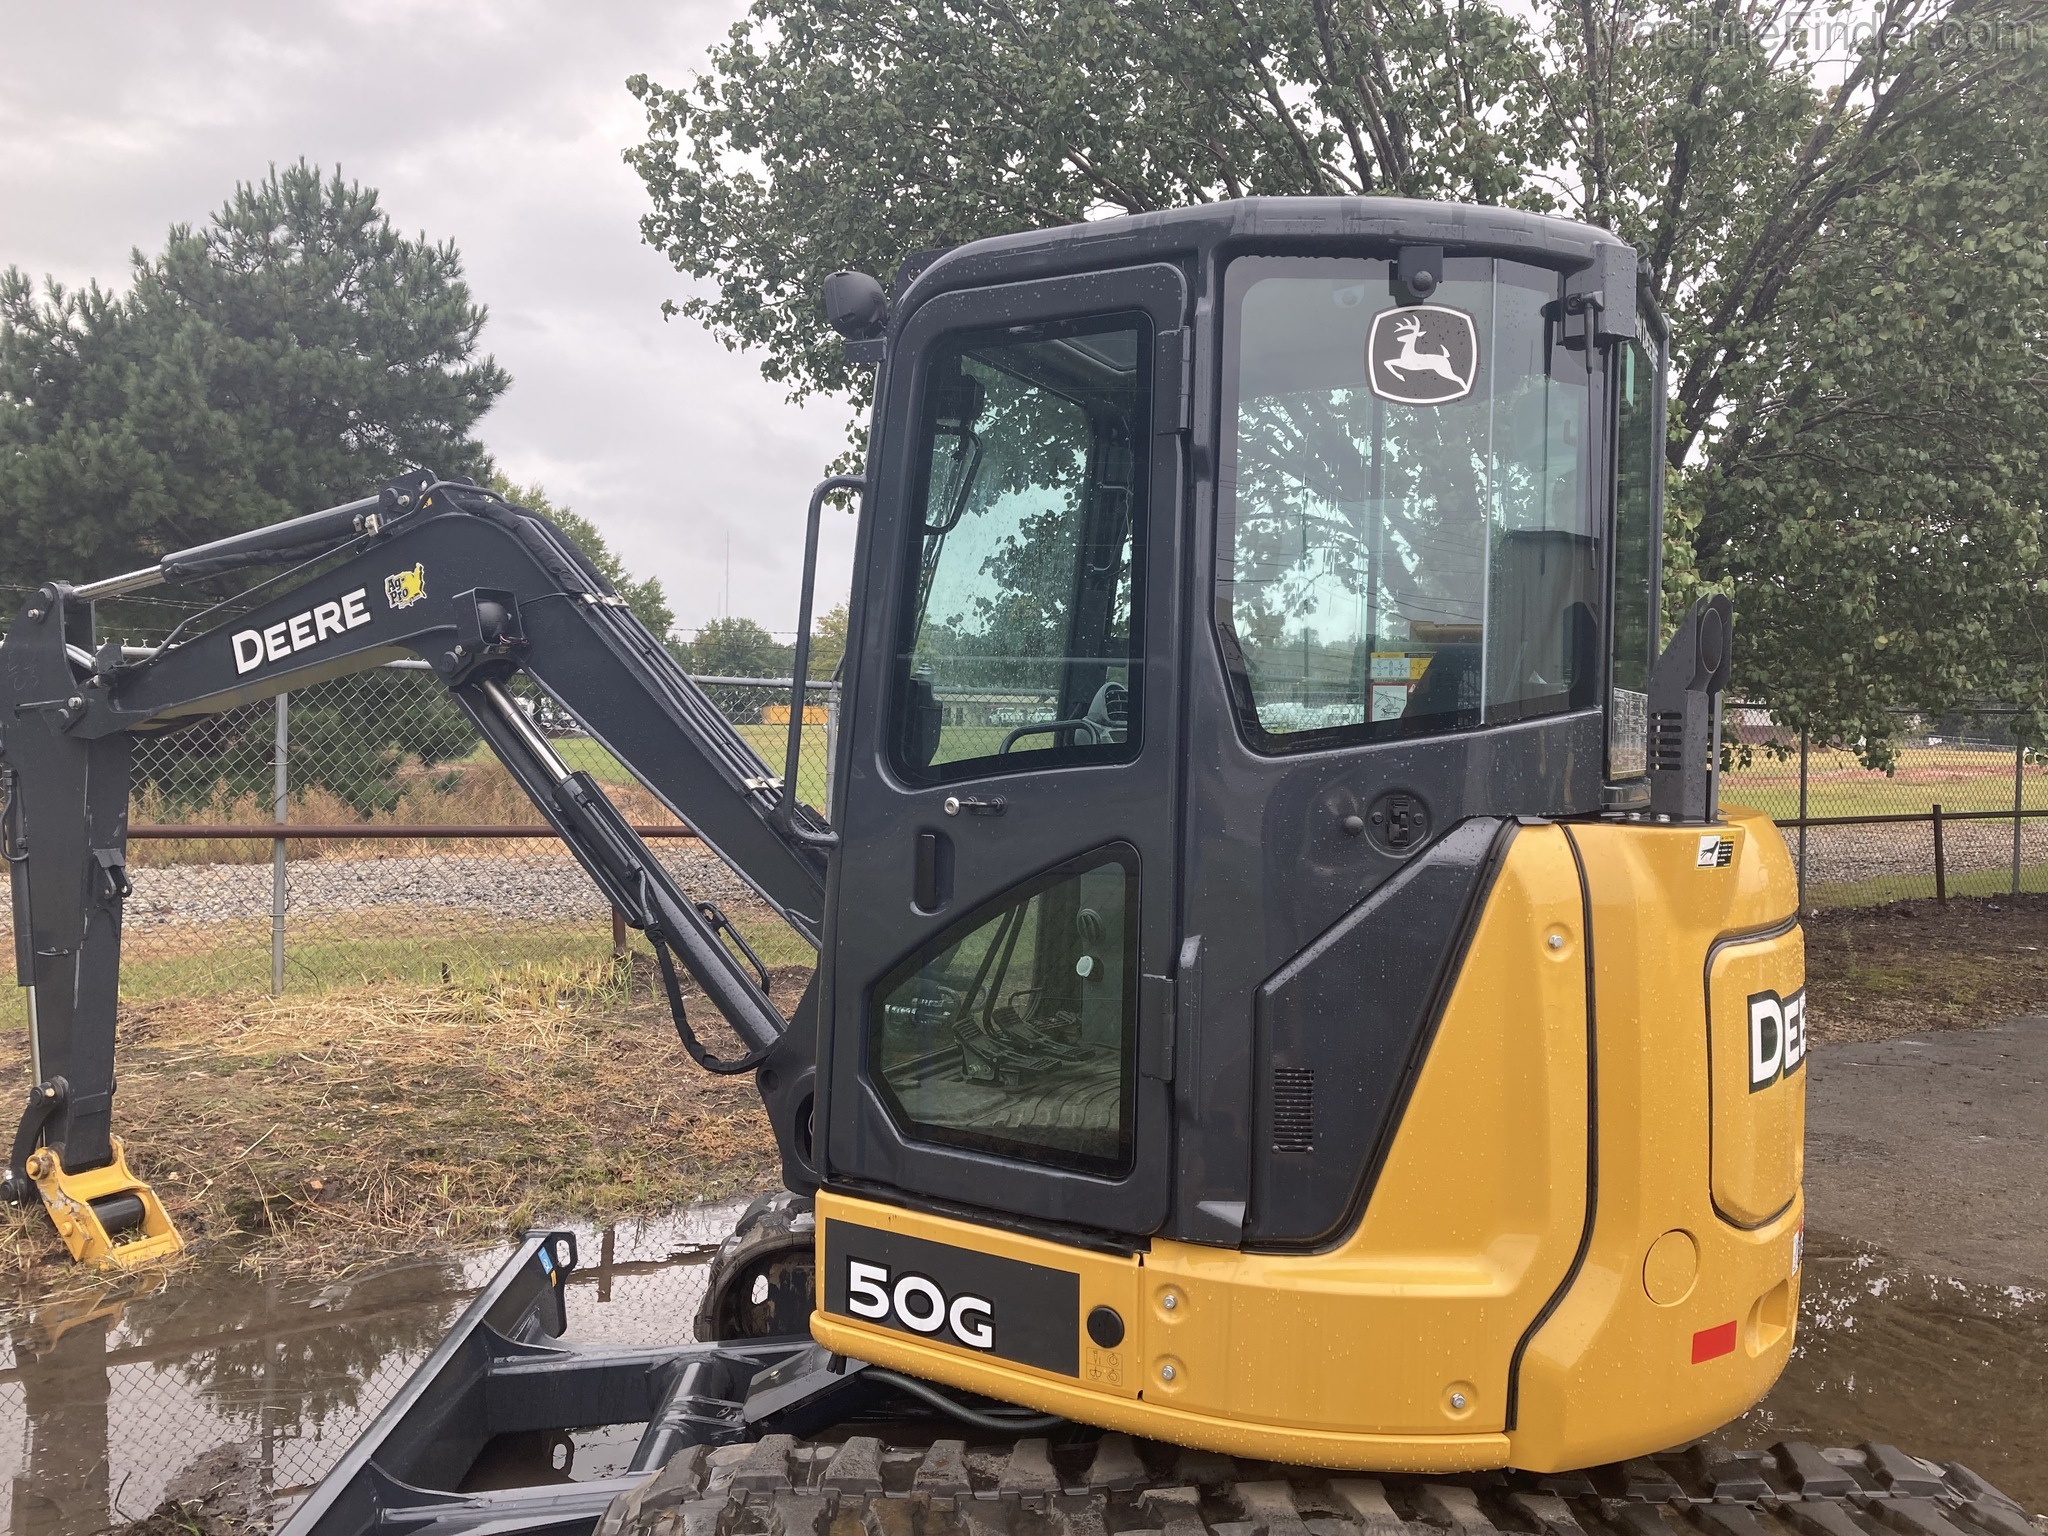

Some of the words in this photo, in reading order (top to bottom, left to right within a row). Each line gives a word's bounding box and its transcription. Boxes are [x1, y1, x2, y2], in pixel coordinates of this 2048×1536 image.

[231, 587, 371, 675] DEERE
[390, 588, 408, 604] Pro
[849, 1261, 993, 1348] 50G
